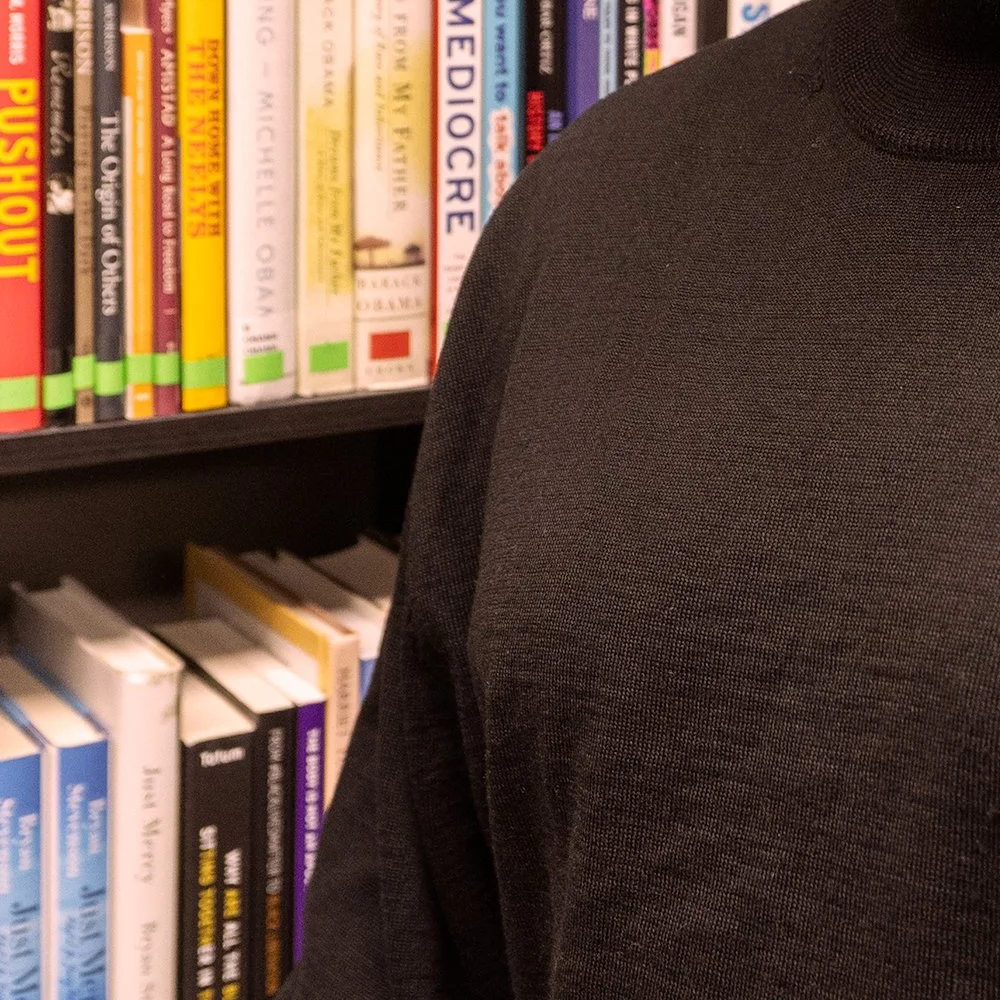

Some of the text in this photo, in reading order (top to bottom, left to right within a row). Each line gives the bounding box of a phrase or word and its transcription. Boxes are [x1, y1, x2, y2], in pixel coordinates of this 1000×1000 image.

[8, 12, 25, 65] MORRIS
[103, 1, 117, 73] MORRISON
[624, 6, 640, 23] IN
[391, 12, 408, 73] FROM
[494, 23, 510, 74] want
[624, 25, 641, 67] WHITE
[160, 49, 176, 128] AMISTAD
[321, 39, 336, 108] OBAMA
[391, 80, 412, 117] MY
[494, 81, 510, 103] to
[186, 42, 206, 240] THE NEELYS
[205, 38, 222, 239] DOWN HOME WITH
[495, 114, 510, 152] talk
[0, 77, 39, 285] PUSHOUT
[157, 152, 175, 184] Long
[254, 89, 277, 230] MICHELLE
[391, 126, 412, 212] FATHER
[94, 111, 122, 317] The Origin of Others
[159, 186, 175, 217] Road
[160, 220, 175, 237] to
[159, 238, 175, 295] Freedom
[199, 747, 246, 768] Tatum
[142, 765, 161, 809] Just
[134, 817, 162, 884] Mercy
[223, 849, 242, 886] WHY
[80, 885, 107, 940] Just
[222, 920, 242, 950] ALL
[197, 967, 217, 988] IN
[221, 951, 242, 982] THE
